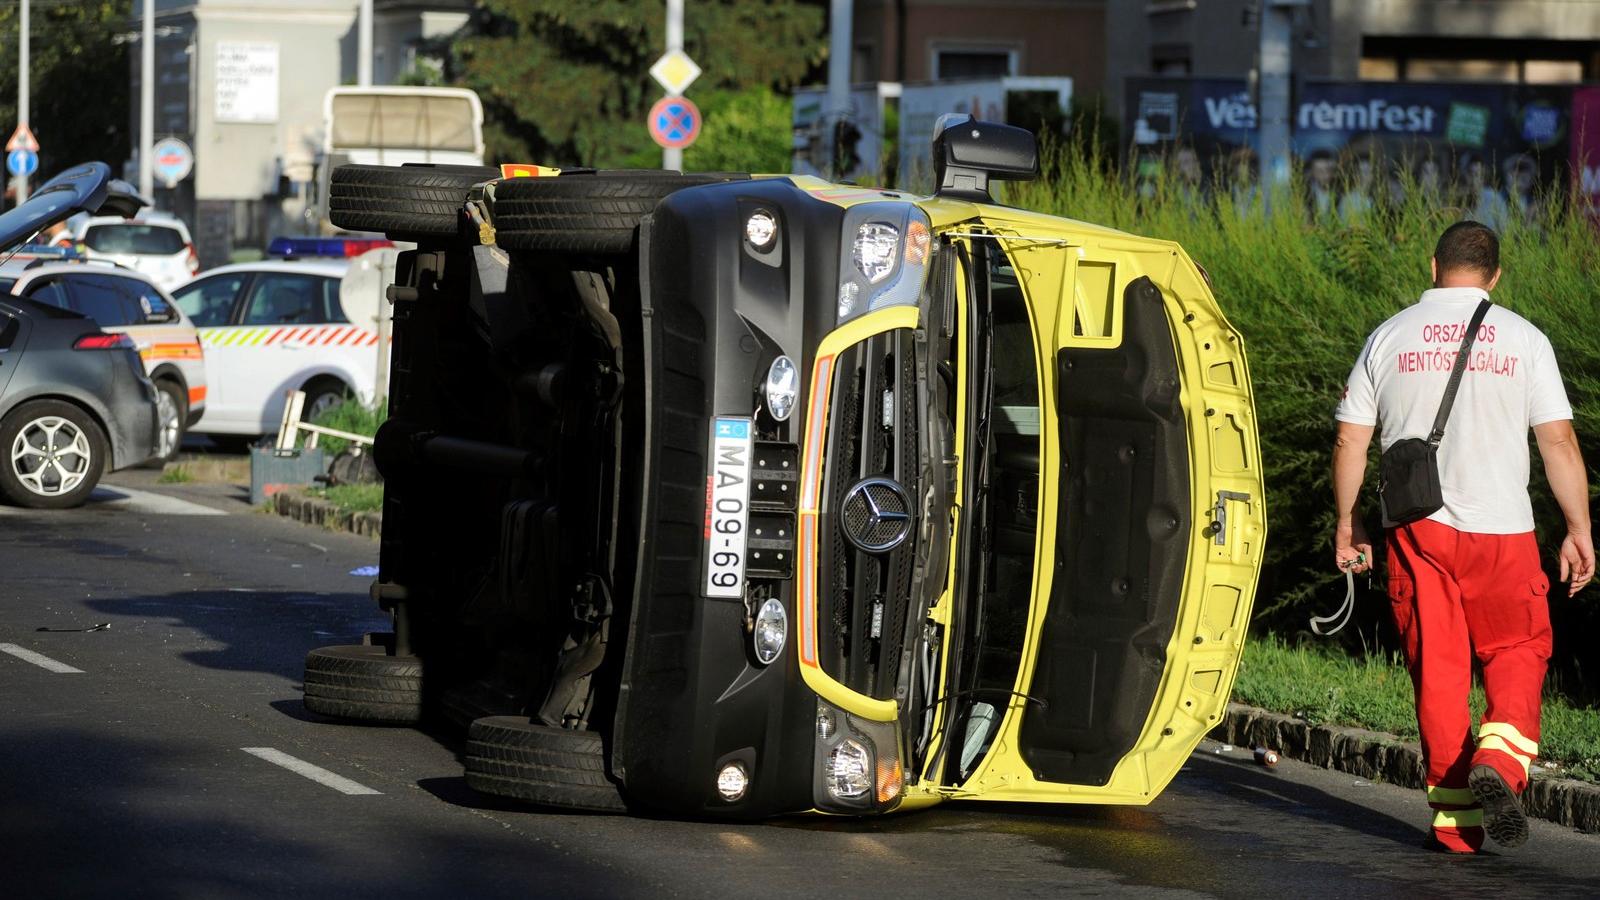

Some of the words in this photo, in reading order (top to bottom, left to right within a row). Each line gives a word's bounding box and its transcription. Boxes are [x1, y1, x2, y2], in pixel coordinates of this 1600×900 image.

[1423, 320, 1496, 343] ORSZÁOS
[1398, 347, 1518, 377] MENTŐSZLGÁLAT
[719, 424, 731, 435] H
